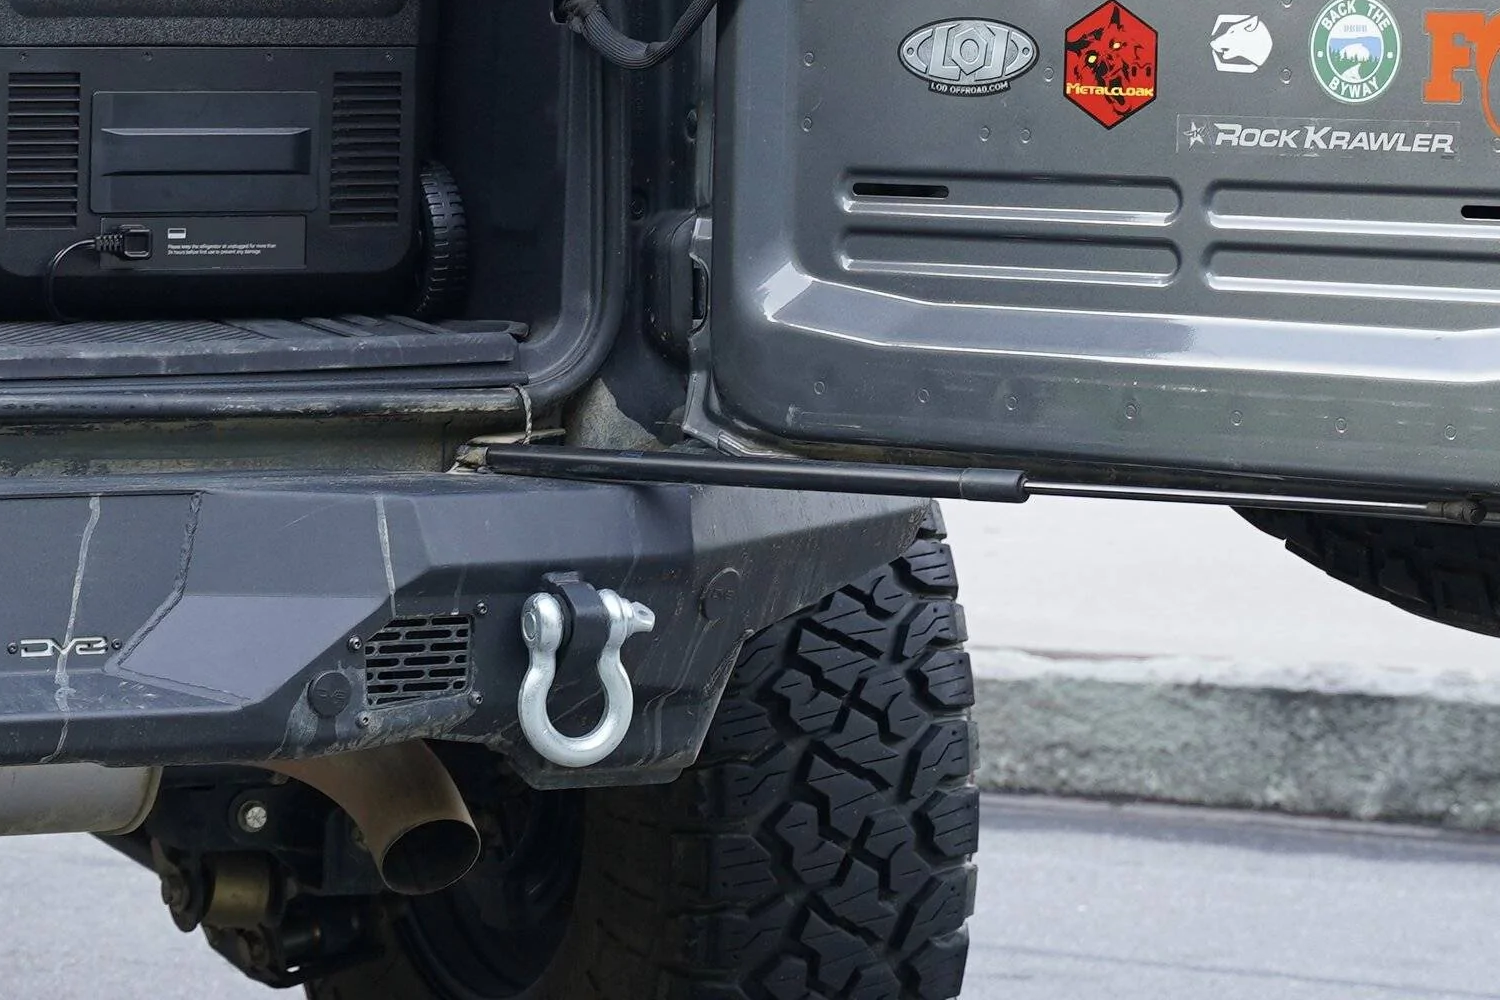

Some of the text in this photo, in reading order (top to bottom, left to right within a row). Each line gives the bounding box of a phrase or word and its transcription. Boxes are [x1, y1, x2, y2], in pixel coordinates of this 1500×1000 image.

[1321, 0, 1391, 31] BACK THE
[1328, 76, 1379, 98] BYWAY
[1213, 123, 1455, 153] ROCK KRAWLER
